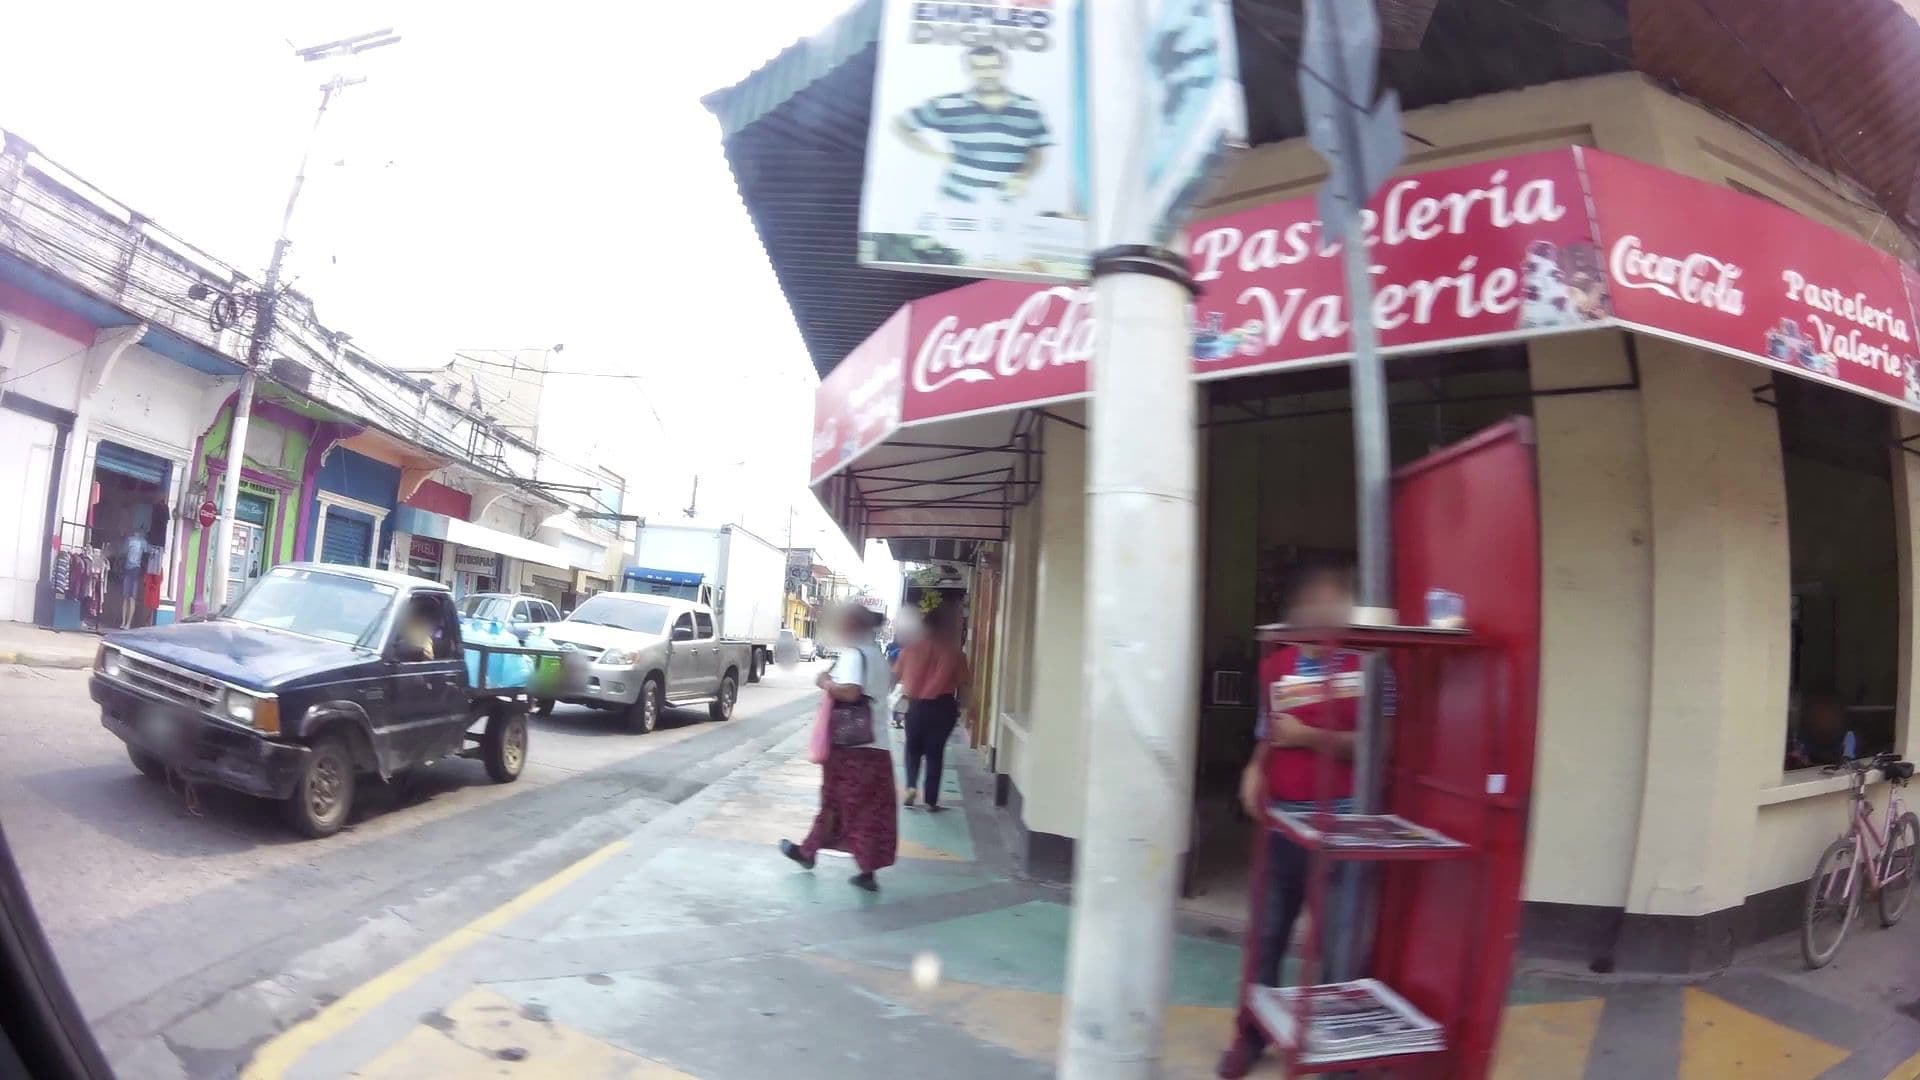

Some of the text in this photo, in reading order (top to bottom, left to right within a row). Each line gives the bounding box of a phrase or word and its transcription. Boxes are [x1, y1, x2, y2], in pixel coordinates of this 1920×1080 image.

[1236, 255, 1522, 347] Vaerie
[1781, 269, 1911, 343] Pasteleria
[1807, 313, 1903, 378] Valerie
